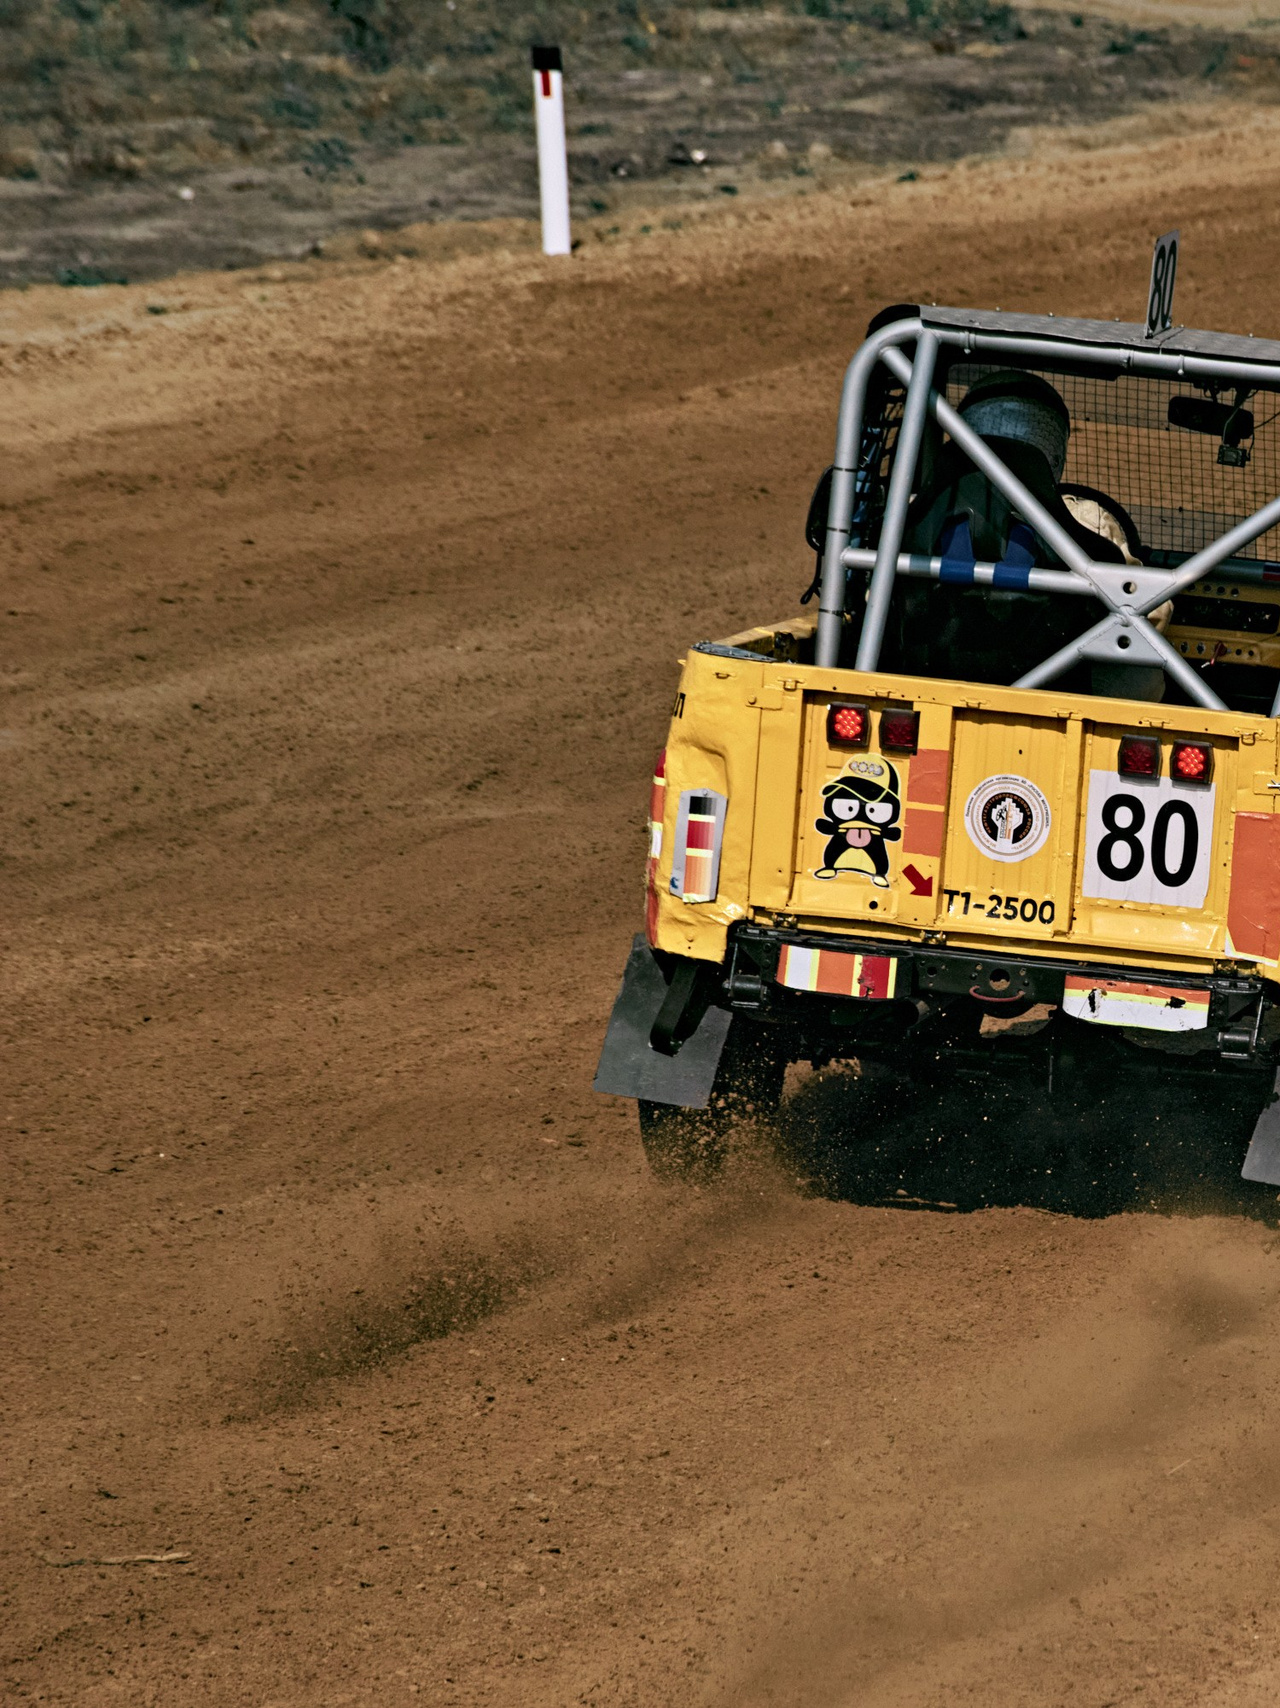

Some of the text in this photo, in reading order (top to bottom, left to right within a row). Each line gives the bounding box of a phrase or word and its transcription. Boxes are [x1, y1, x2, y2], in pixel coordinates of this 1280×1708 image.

[1148, 239, 1177, 332] 80
[1097, 793, 1199, 887] 80
[943, 889, 1055, 924] T1-2500
